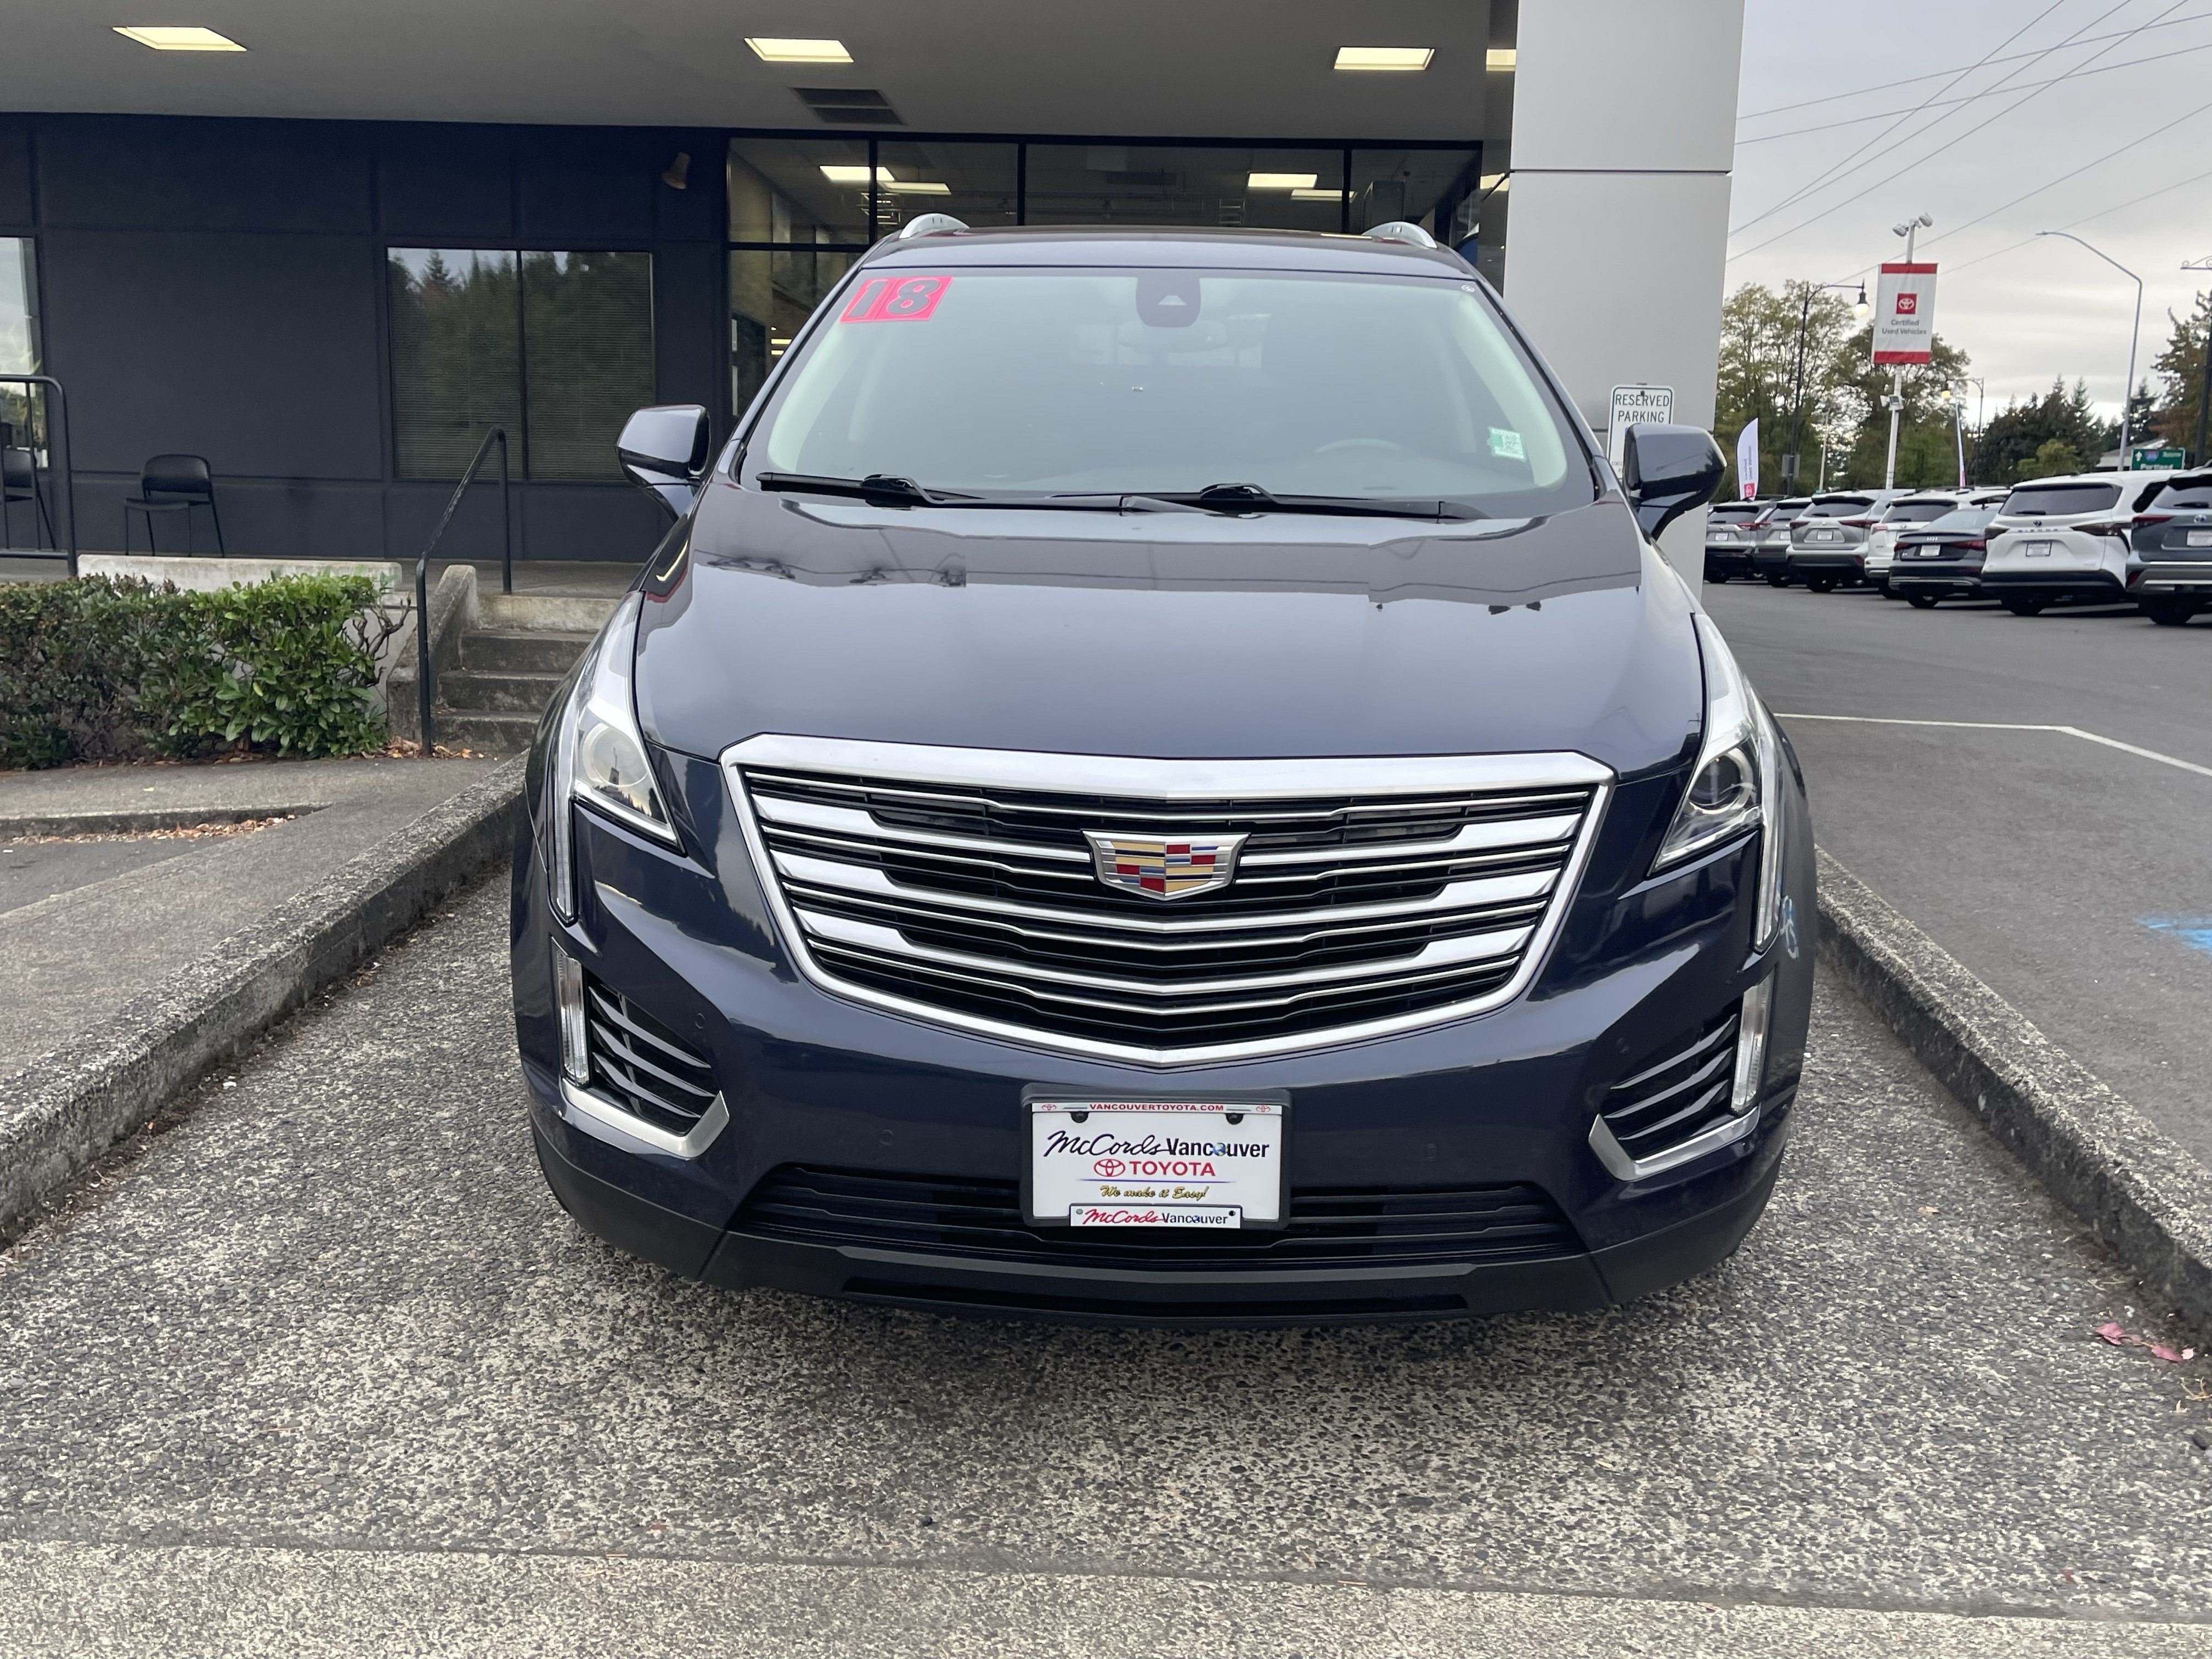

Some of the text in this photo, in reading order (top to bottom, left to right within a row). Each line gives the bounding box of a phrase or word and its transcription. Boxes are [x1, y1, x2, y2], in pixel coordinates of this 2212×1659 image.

[847, 280, 940, 318] 18
[1615, 394, 1669, 407] RESERVED
[1618, 410, 1664, 422] PARKING
[1043, 1130, 1169, 1157] McCords
[1129, 1160, 1216, 1177] TOYOTA
[1100, 1185, 1209, 1201] We make it Easy!
